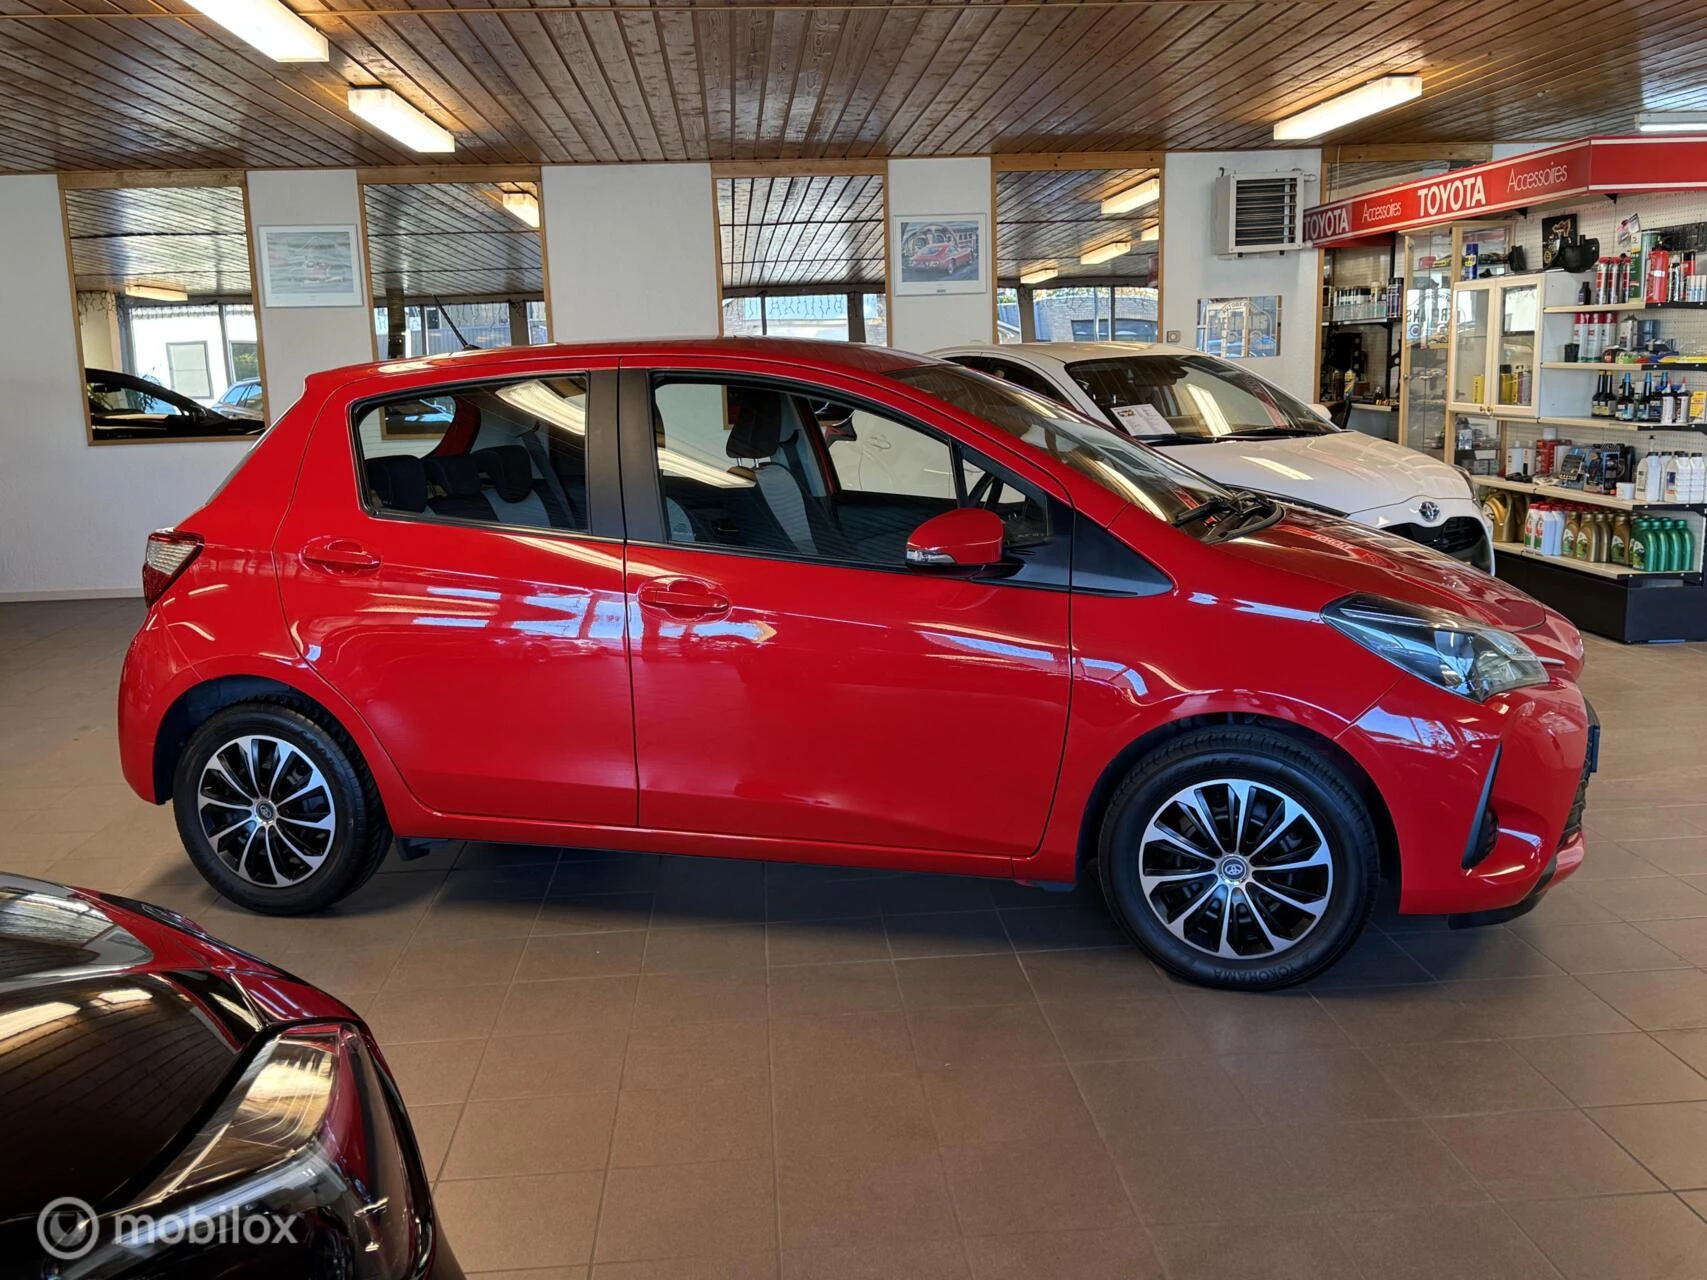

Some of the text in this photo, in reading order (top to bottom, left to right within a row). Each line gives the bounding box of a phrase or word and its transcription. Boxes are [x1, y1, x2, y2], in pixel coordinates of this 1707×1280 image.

[1303, 161, 1568, 240] TOYOTA Accessoires TOYOTA Accessoires
[1213, 962, 1297, 982] YOKOHAMA
